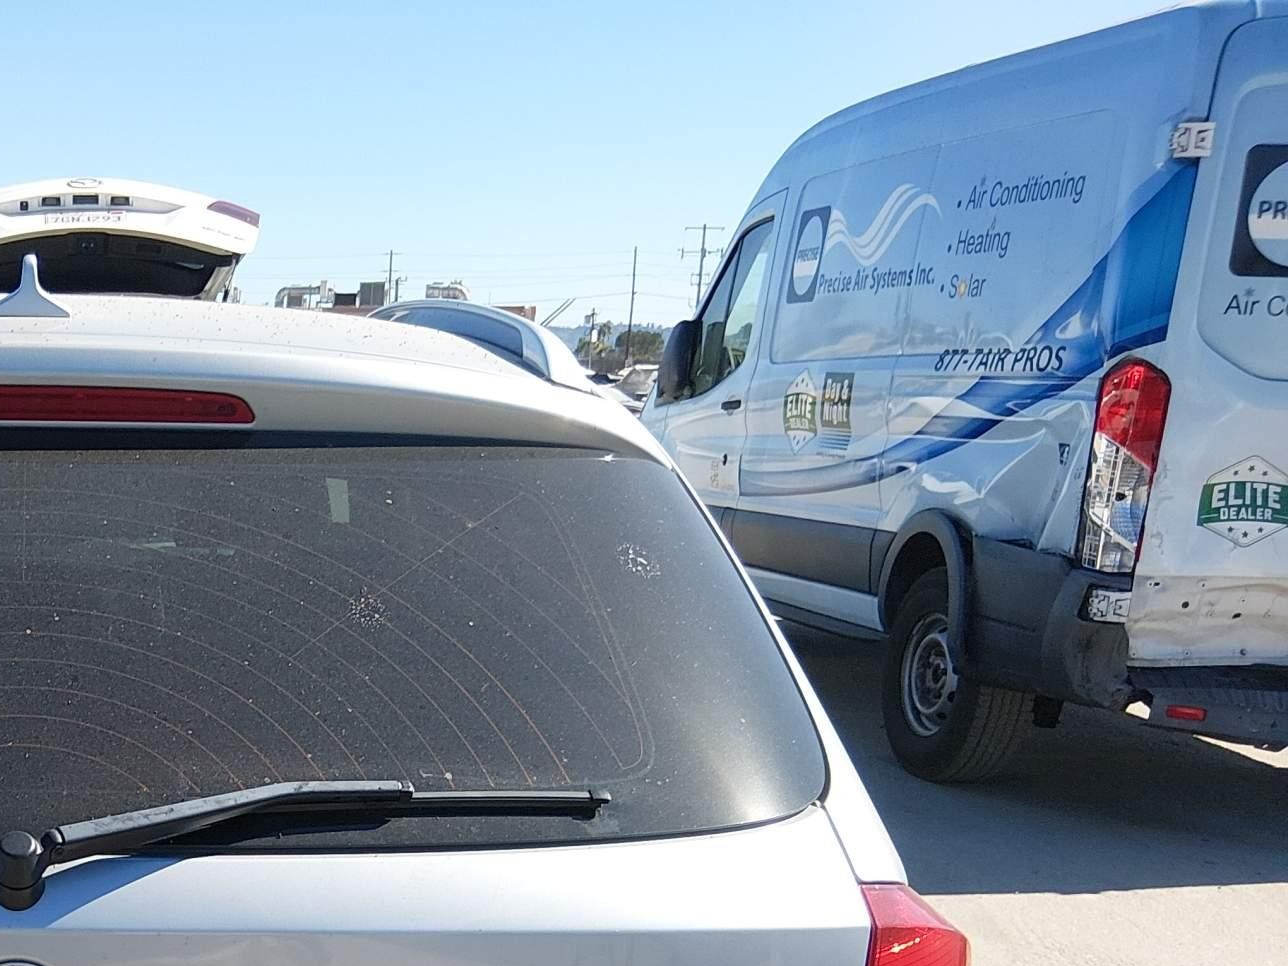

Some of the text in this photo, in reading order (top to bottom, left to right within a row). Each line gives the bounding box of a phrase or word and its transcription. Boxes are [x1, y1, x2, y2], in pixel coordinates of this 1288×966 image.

[965, 171, 1087, 210] Air Conditioning
[955, 225, 1011, 259] Heating
[817, 262, 935, 297] Precise Air Systems Inc.
[1223, 290, 1288, 316] Air C
[934, 345, 1067, 373] 877-7AIR PROS
[824, 378, 849, 402] Day &
[786, 393, 813, 419] ELITE
[823, 400, 848, 425] Night
[1211, 481, 1283, 510] ELITE
[1219, 507, 1274, 521] DEALER
